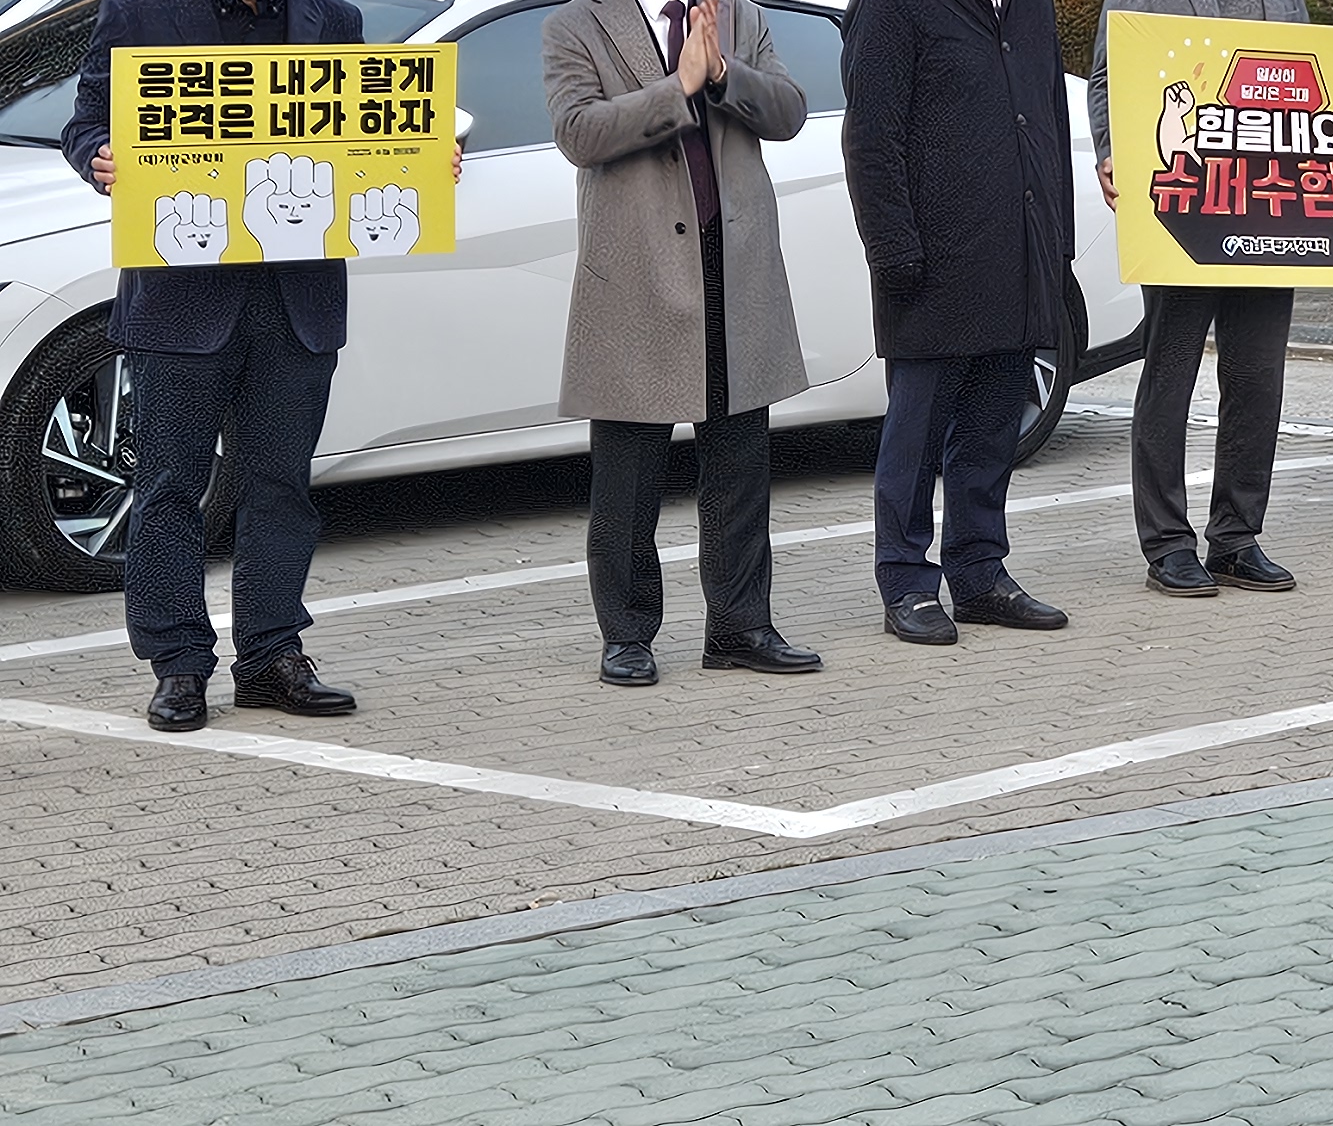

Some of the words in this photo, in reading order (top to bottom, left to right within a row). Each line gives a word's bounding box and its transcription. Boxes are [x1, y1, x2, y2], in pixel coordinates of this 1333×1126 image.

[137, 60, 255, 99] 응원은
[269, 58, 348, 96] 내가
[358, 56, 435, 94] 할게
[137, 103, 255, 142] 합격은
[269, 99, 347, 138] 네가
[358, 97, 436, 135] 하자
